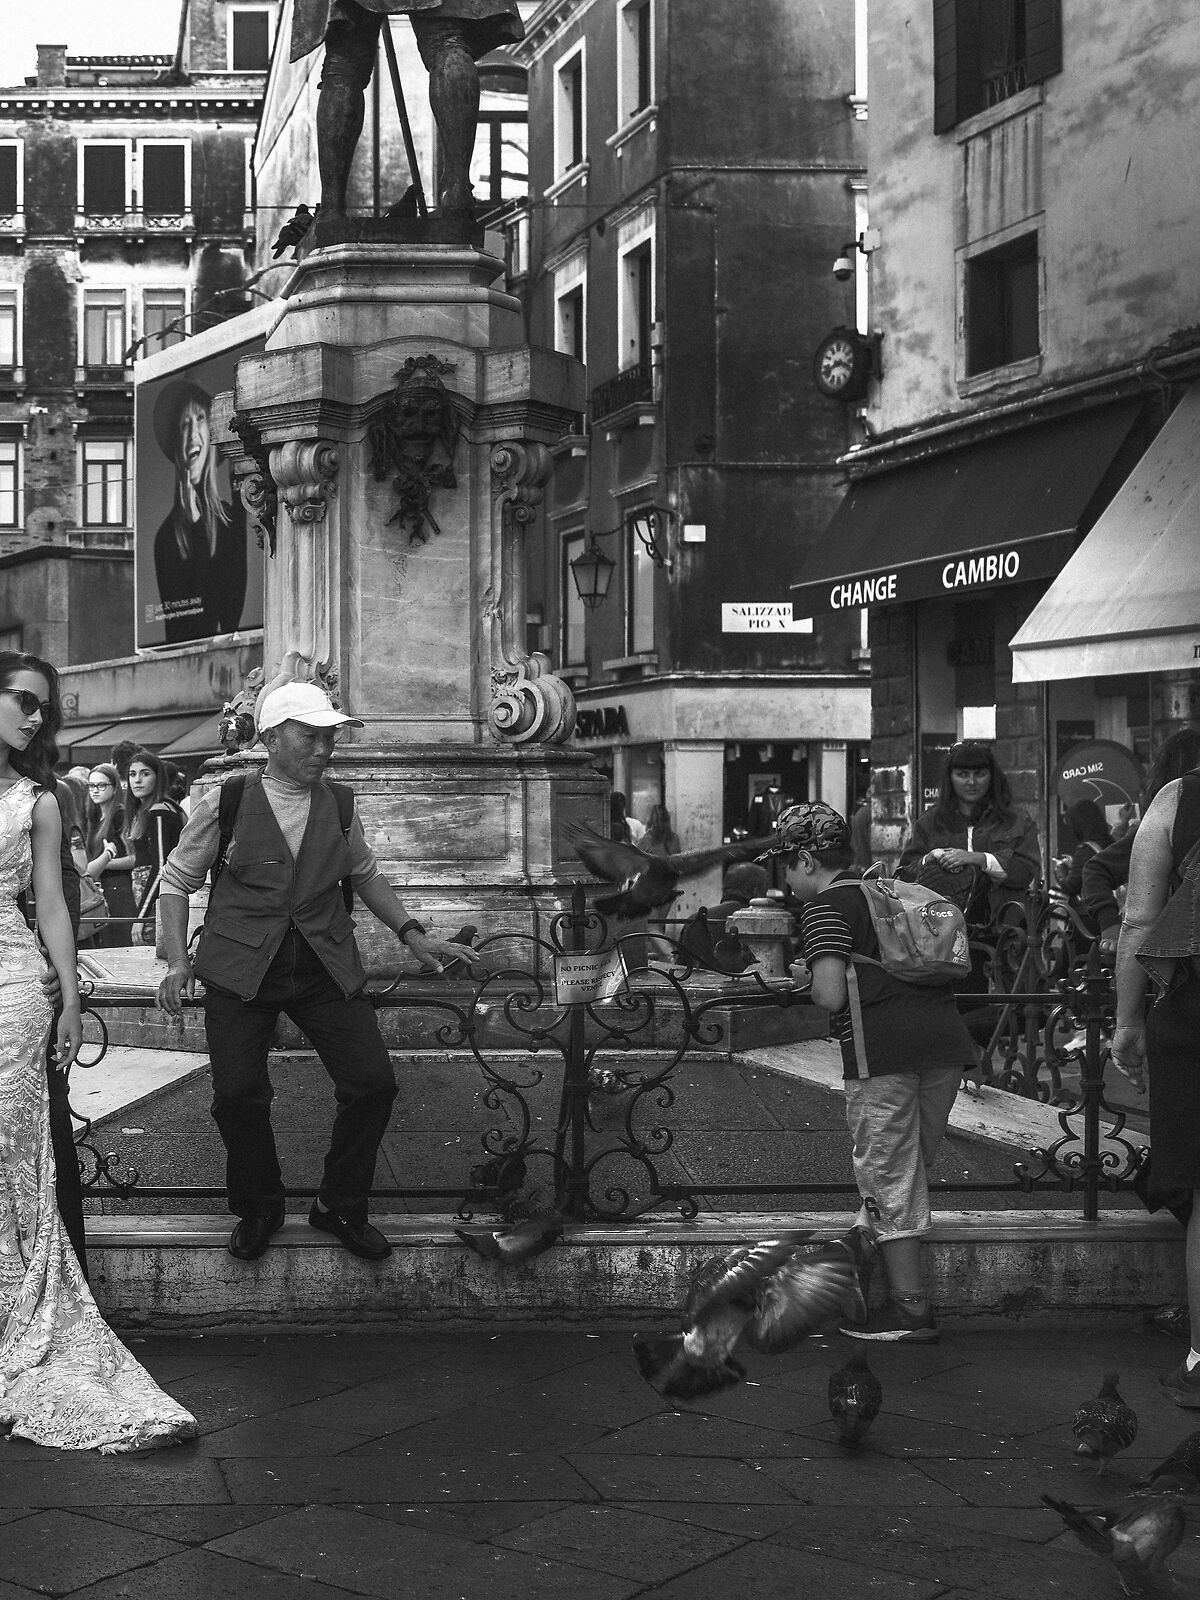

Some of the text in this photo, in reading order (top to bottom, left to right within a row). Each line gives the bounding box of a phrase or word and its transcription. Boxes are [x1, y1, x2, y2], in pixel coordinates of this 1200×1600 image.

[830, 551, 1020, 609] CHANGE CAMBIO
[732, 606, 791, 616] SALIZZAD
[749, 619, 770, 628] PIO
[924, 788, 940, 798] CHA
[573, 963, 599, 972] PICNIC
[562, 978, 590, 986] PLEASE
